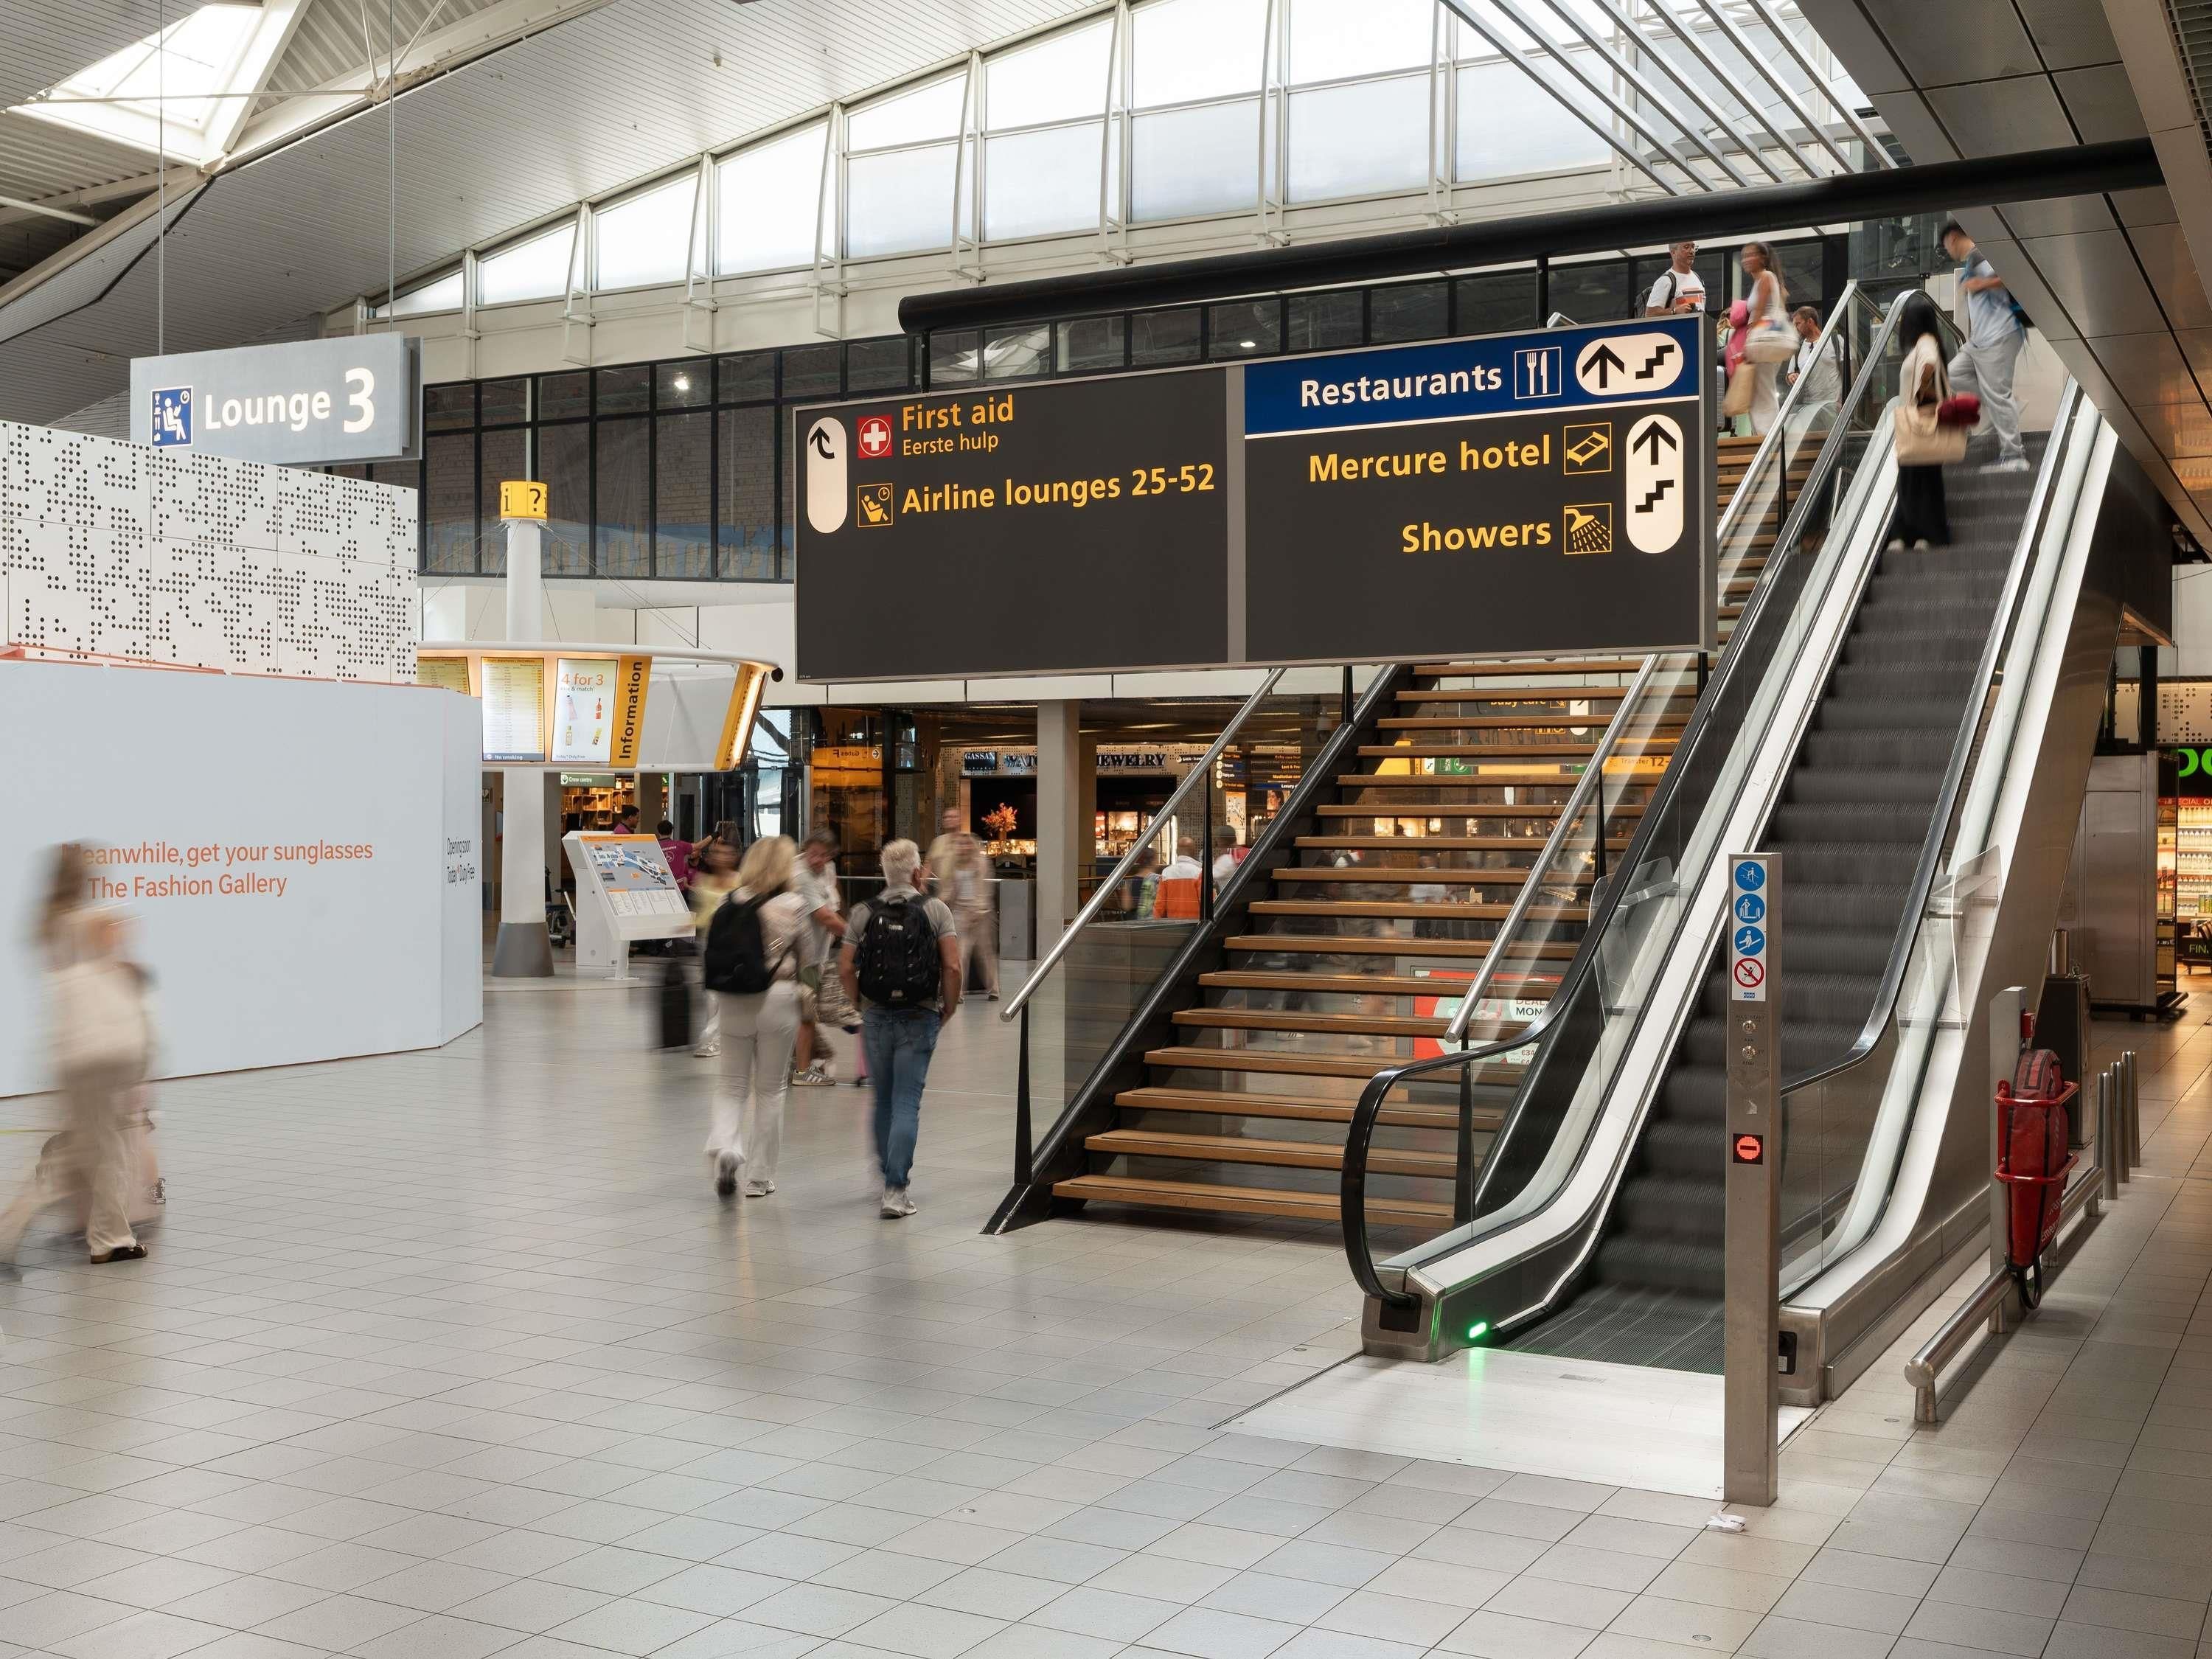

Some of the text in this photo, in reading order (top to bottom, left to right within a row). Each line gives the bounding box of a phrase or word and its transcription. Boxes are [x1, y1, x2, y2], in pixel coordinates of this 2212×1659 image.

[205, 367, 375, 434] Lounge 3
[1301, 365, 1502, 407] Restaurants
[902, 394, 1014, 431] First aid
[902, 431, 998, 456] Eerste hulp
[1310, 434, 1550, 482] Mercure hotel
[902, 463, 1214, 514] Airline lounges 25-52
[1402, 522, 1551, 553] Showers
[561, 672, 604, 686] 4 for 3
[619, 661, 643, 759] Information
[964, 752, 995, 760] GASSAN
[1003, 755, 1038, 767] WAT
[186, 843, 220, 868] get
[225, 845, 269, 867] your
[274, 839, 373, 865] sunglasses
[88, 872, 288, 900] The Fashion Gallery
[2189, 943, 2209, 954] FIN
[1516, 1007, 1544, 1016] MON
